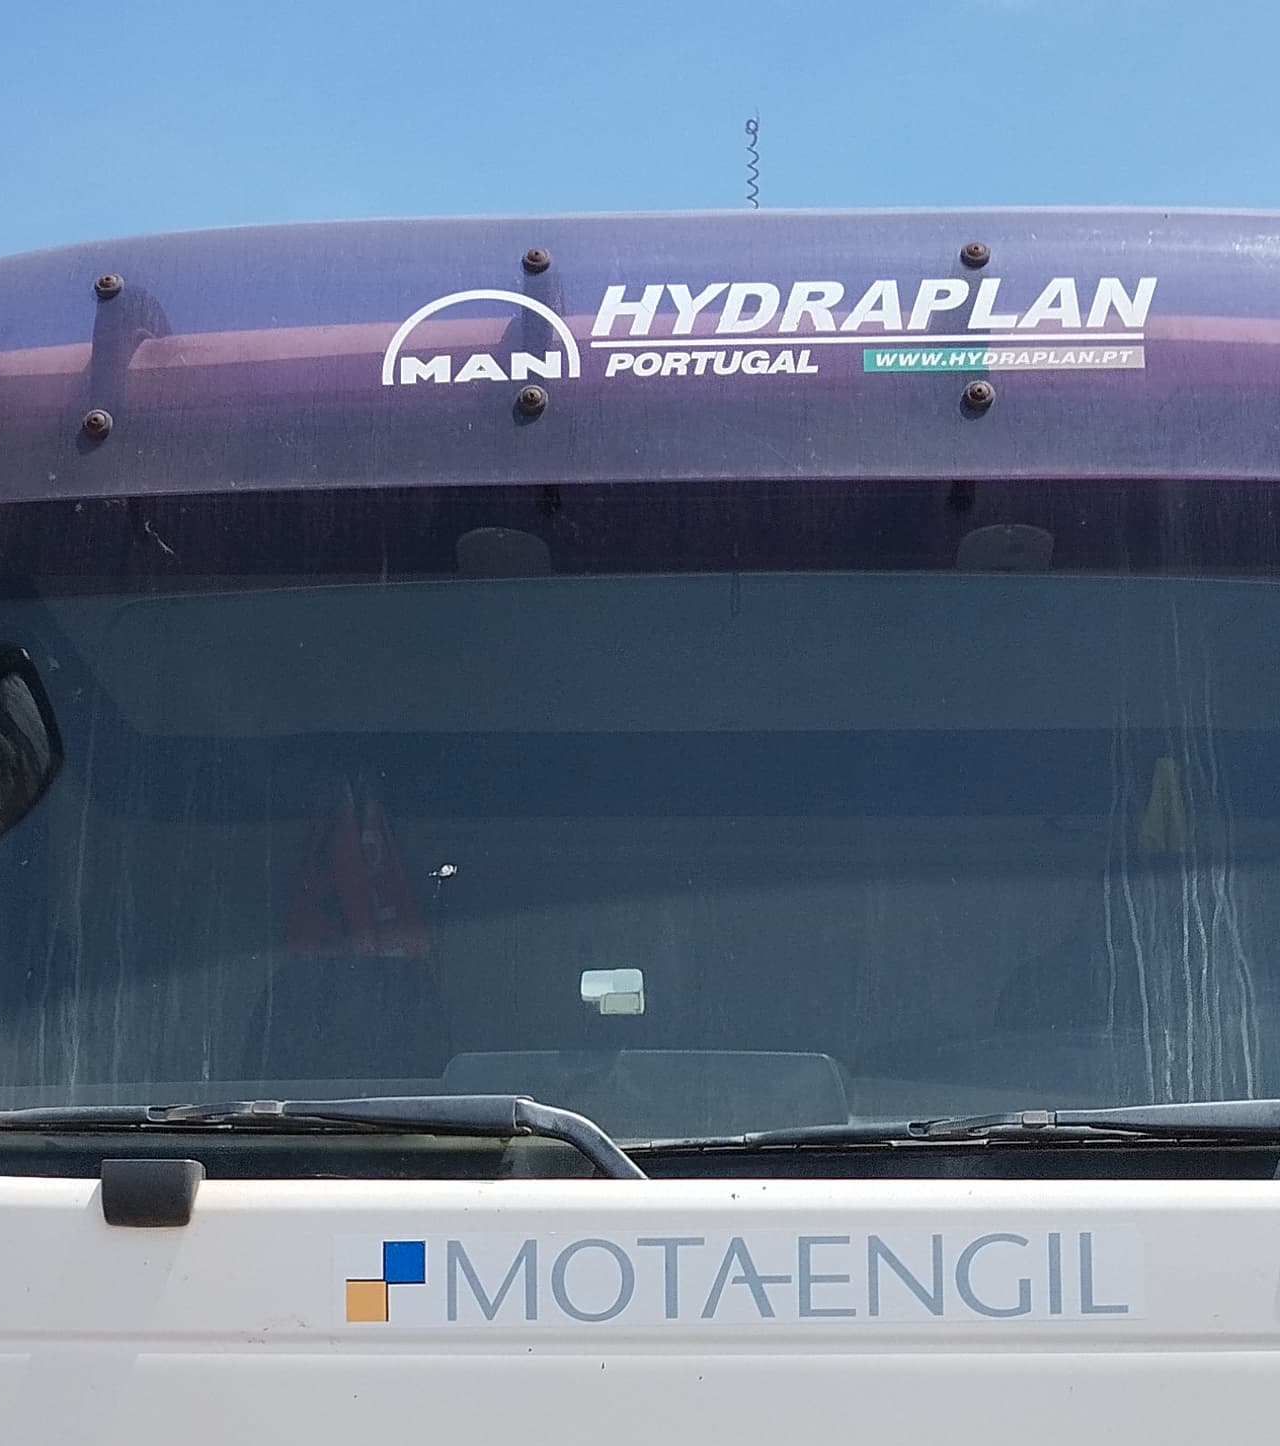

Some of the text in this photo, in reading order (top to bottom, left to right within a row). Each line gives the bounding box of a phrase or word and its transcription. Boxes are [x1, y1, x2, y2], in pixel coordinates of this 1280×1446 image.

[591, 277, 1158, 337] HYDRAPLAN
[400, 351, 563, 385] MAN
[605, 349, 820, 377] PORTUGAL
[876, 351, 1133, 368] WWW.HYDRAPLAN.PT
